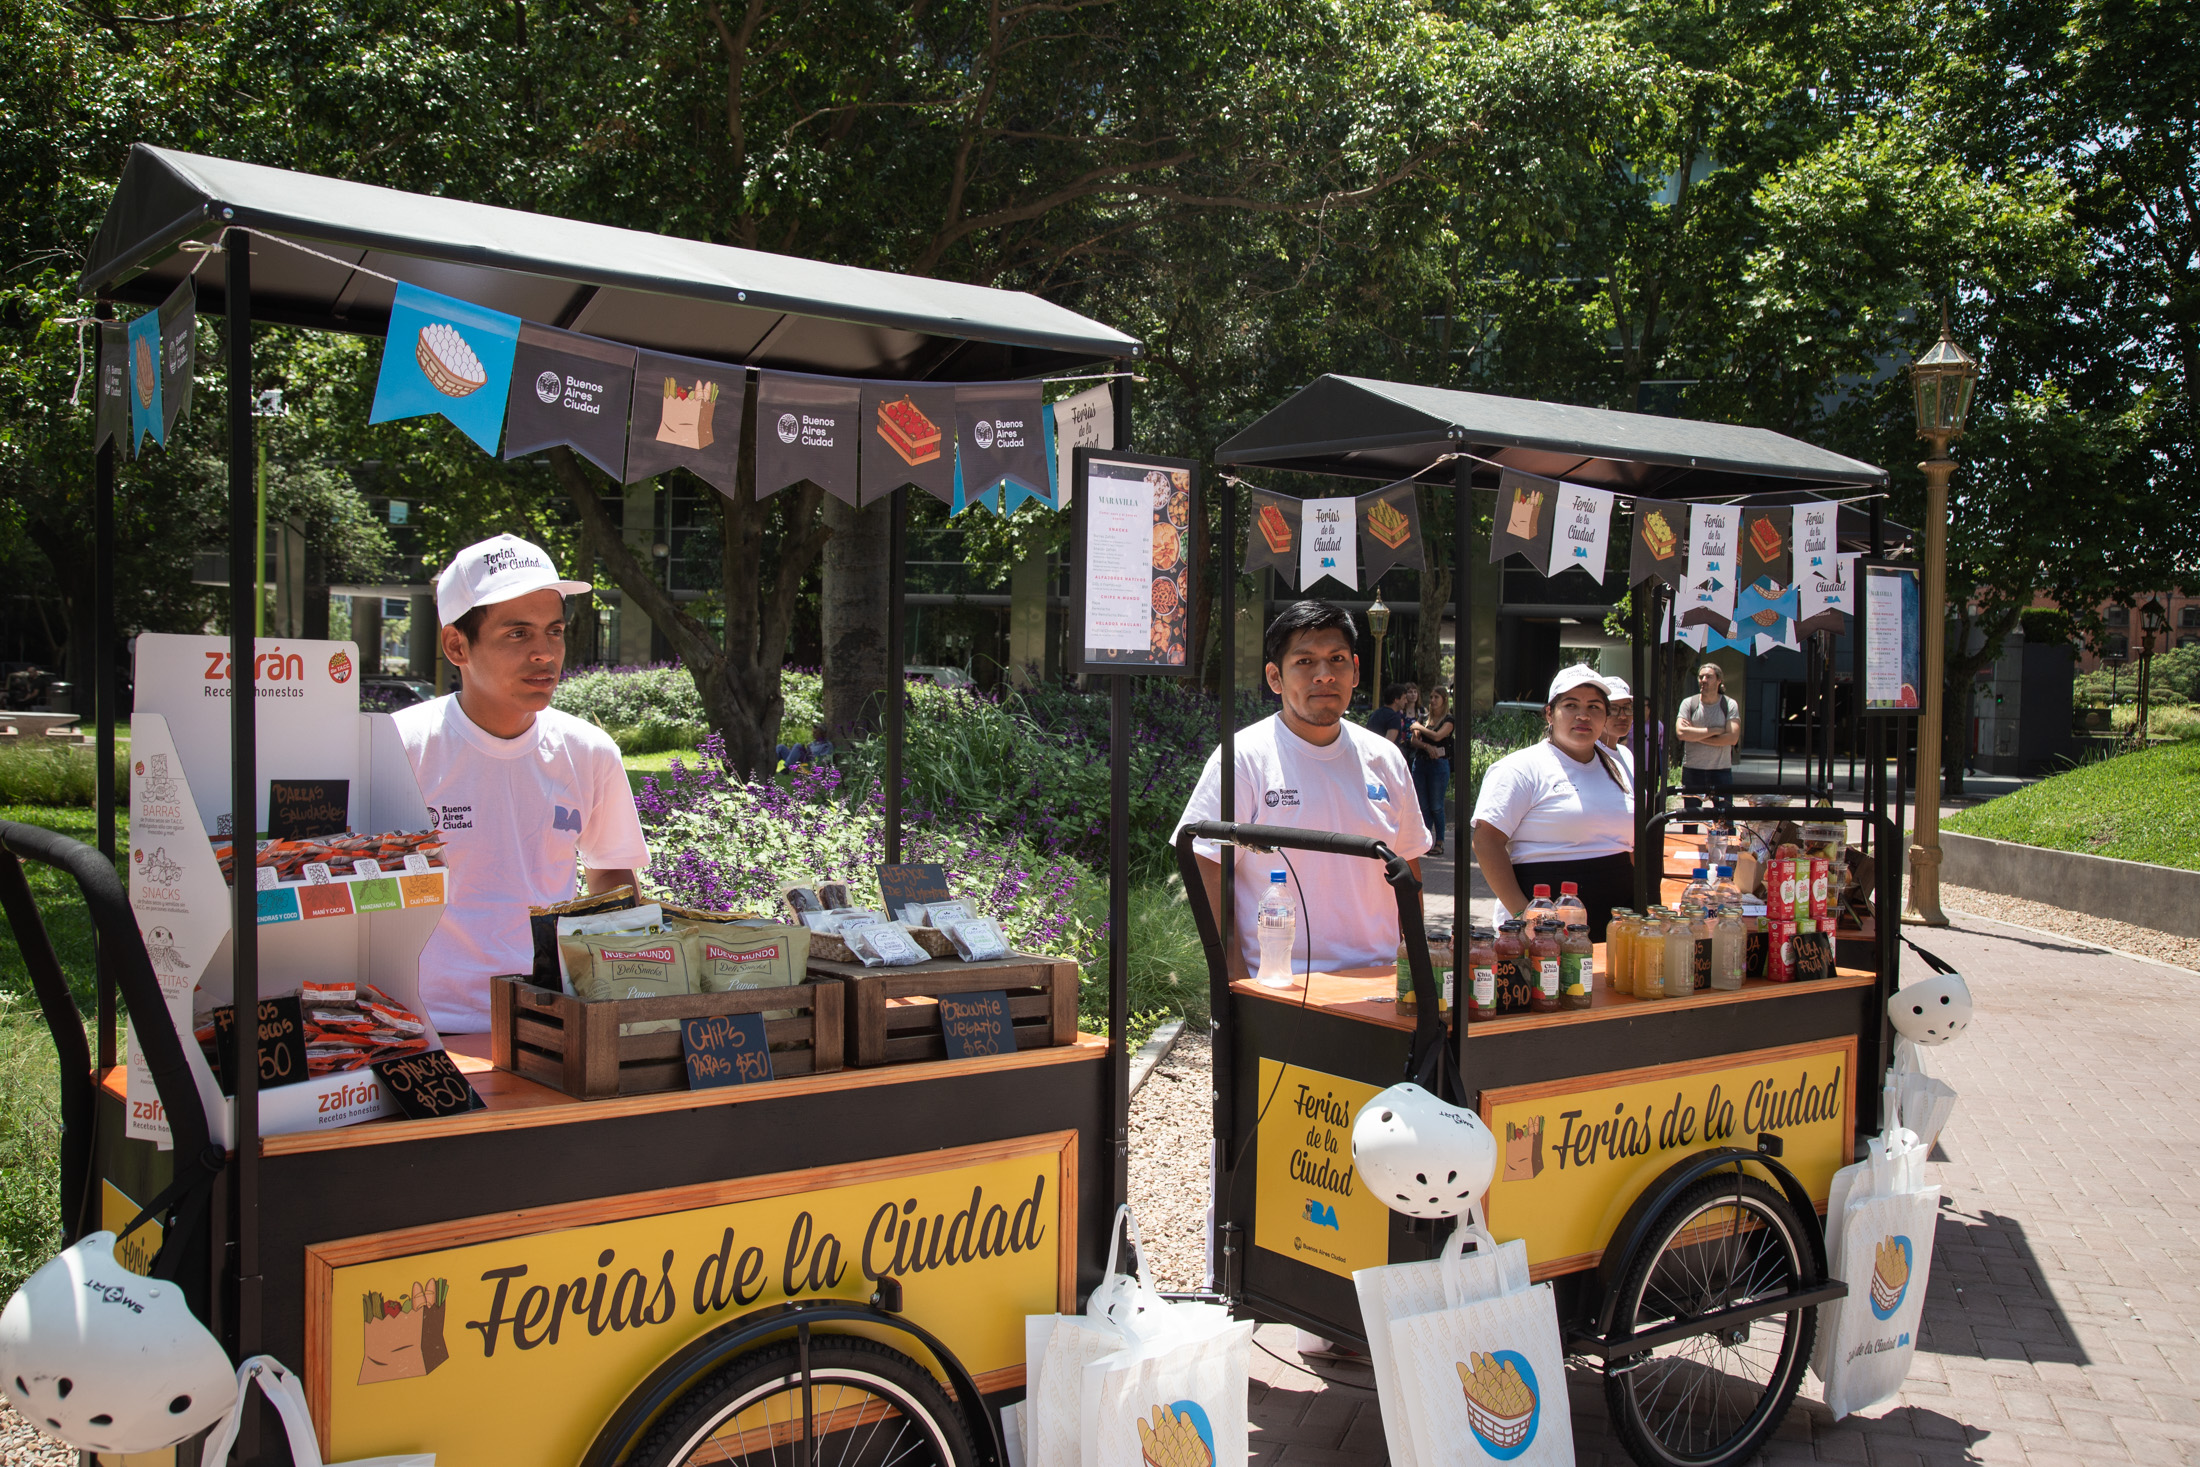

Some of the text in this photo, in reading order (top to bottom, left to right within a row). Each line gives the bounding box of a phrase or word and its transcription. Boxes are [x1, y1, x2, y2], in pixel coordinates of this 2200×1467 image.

[566, 375, 604, 393] Buenos
[564, 387, 593, 402] Aires
[563, 398, 600, 415] Ciudad
[1071, 402, 1096, 424] Ferias
[802, 415, 835, 427] Buenos
[995, 420, 1023, 429] Buenos
[801, 425, 827, 436] Aires
[996, 429, 1018, 438] Aires
[801, 436, 834, 447] Ciudad
[997, 438, 1024, 448] Ciudad
[1098, 496, 1139, 507] MARAVILLA
[1572, 495, 1597, 513] Ferias
[1316, 508, 1340, 523] Ferias
[1576, 513, 1590, 525] de la
[1704, 513, 1725, 528] Ferias
[1804, 512, 1825, 526] Ferias
[1321, 524, 1335, 535] de la
[1568, 524, 1595, 543] Ciudad
[1708, 530, 1721, 540] de la
[1810, 526, 1821, 537] de la
[1314, 536, 1342, 552] Ciudad
[1701, 542, 1726, 557] Ciudad
[1804, 535, 1826, 553] Ciudad
[483, 547, 516, 566] Ferias
[509, 557, 541, 570] Ciudad
[1815, 581, 1847, 593] Ciudad
[204, 646, 304, 681] zrán
[143, 804, 181, 818] BARRAS
[441, 805, 472, 814] Buenos
[442, 813, 464, 821] Aires
[442, 821, 473, 830] Ciudad
[142, 886, 181, 901] SNACKS
[257, 914, 279, 923] ENDRAS
[283, 912, 298, 920] COCO
[312, 908, 325, 916] MANÍ
[638, 949, 671, 961] MUNDO
[709, 947, 775, 961] NUEVO MUNDO
[616, 963, 663, 977] Deli Snacks
[719, 962, 737, 973] Deli
[962, 1038, 999, 1057] $50
[257, 1041, 292, 1080] 50
[735, 1050, 769, 1084] $50
[318, 1081, 380, 1113] zafrán
[416, 1077, 467, 1116] $50
[133, 1100, 168, 1122] zafr
[1294, 1083, 1350, 1129] Ferias
[318, 1104, 380, 1125] Recetas honestas
[1552, 1065, 1841, 1171] Ferias de la Ciudad
[133, 1121, 157, 1131] Recetas
[1306, 1125, 1339, 1154] de la
[1289, 1149, 1354, 1197] Ciudad
[1302, 1242, 1347, 1264] Buenos Aires Ciudad
[465, 1173, 1046, 1358] Ferias de la Ciudad
